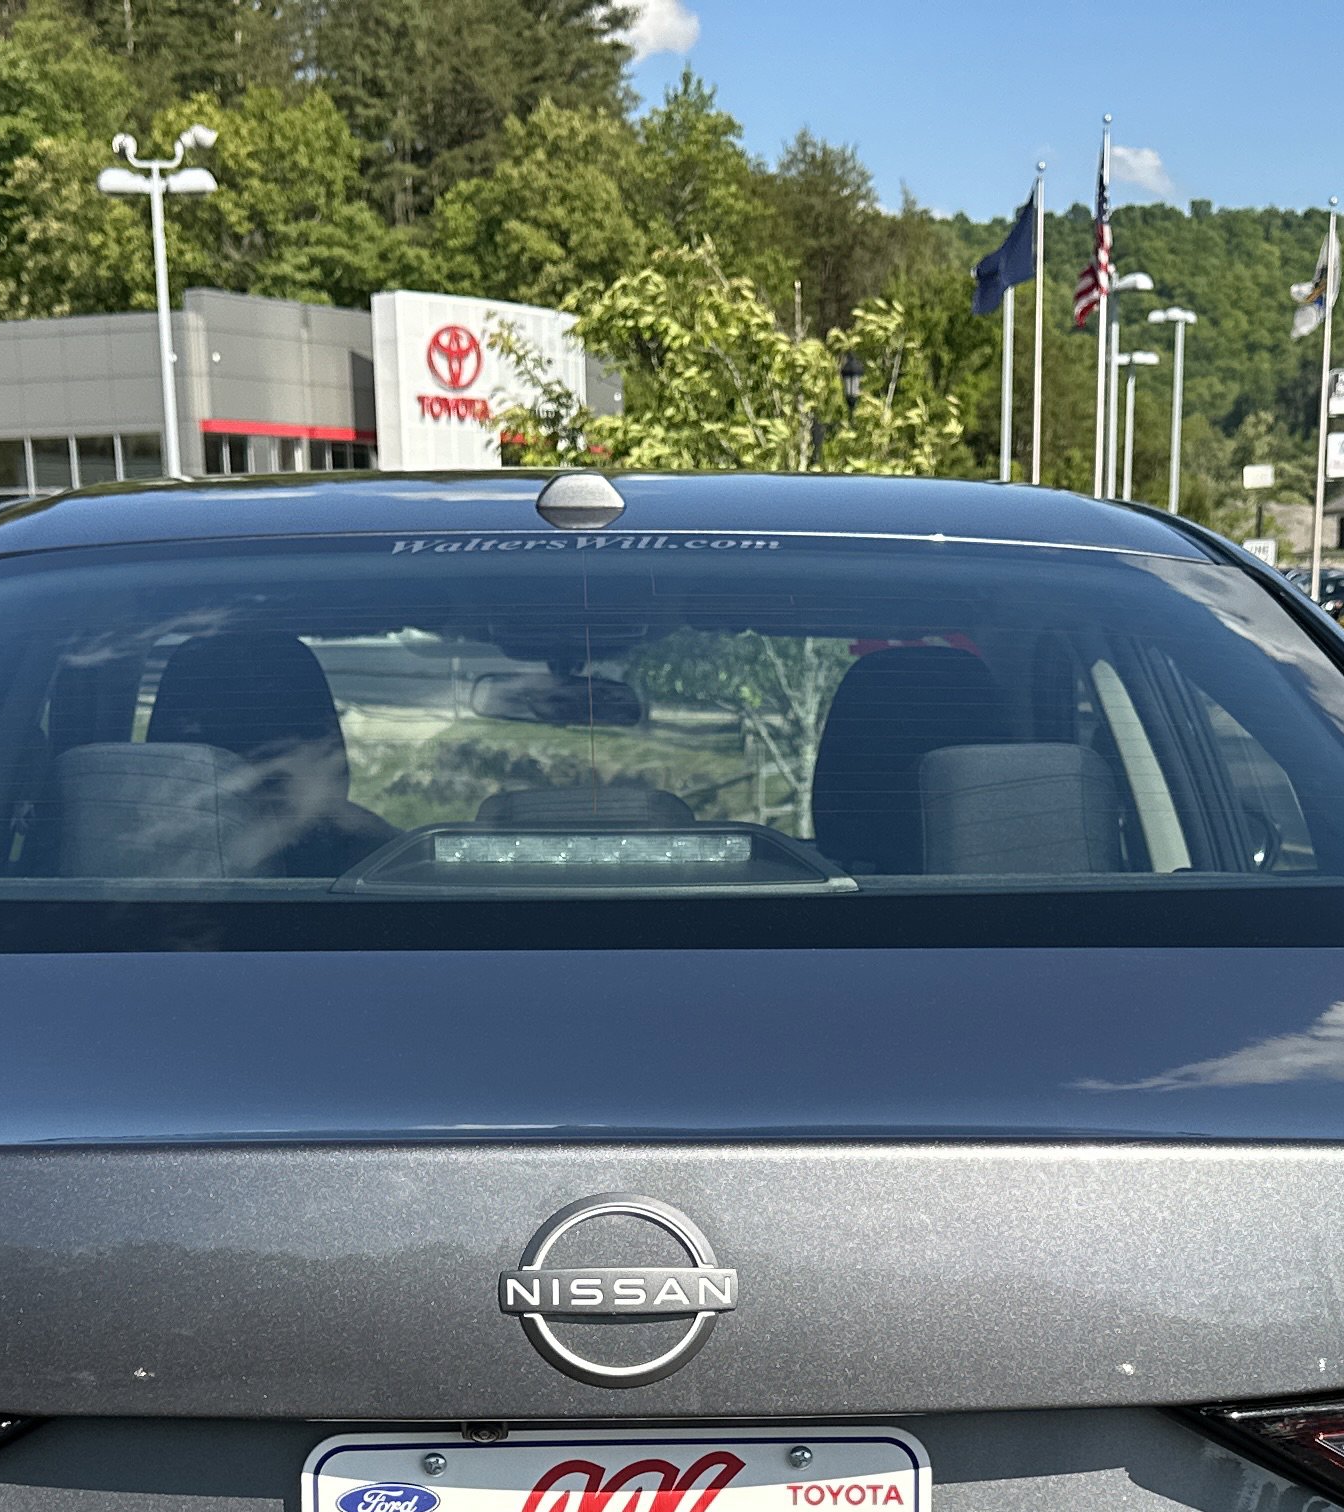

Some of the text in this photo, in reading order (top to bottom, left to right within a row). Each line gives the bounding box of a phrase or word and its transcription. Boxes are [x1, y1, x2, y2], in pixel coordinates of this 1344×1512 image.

[417, 396, 490, 422] TOYOTA
[391, 534, 782, 556] WaltersWill.com
[506, 1277, 733, 1306] NISSAN
[786, 1484, 905, 1506] TOYOTA
